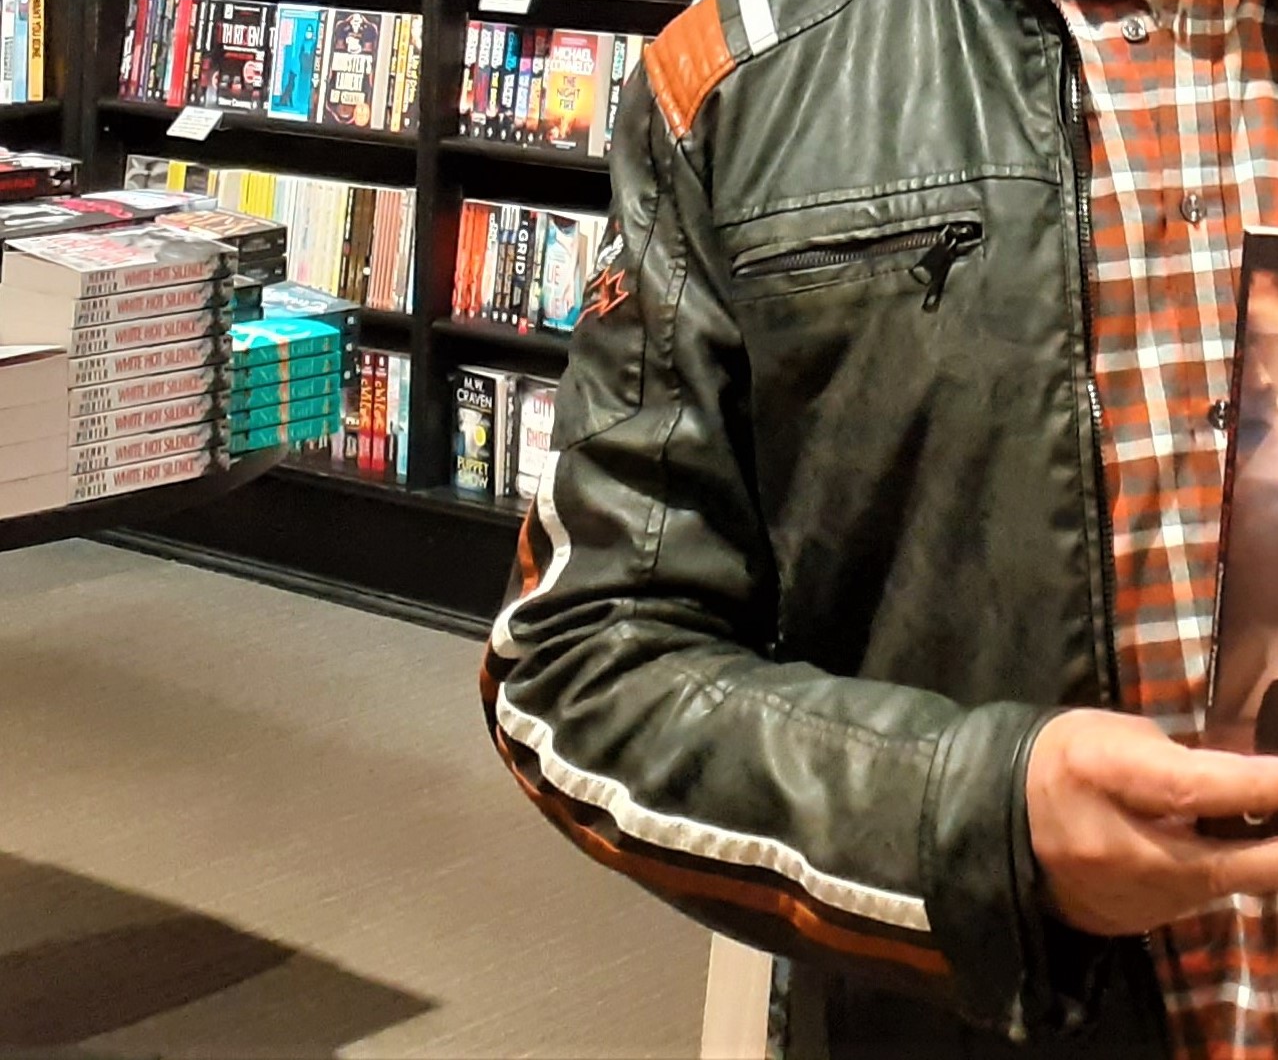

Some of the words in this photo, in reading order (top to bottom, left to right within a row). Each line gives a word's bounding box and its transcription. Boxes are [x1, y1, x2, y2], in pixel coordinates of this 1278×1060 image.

[31, 21, 42, 37] YOU
[562, 75, 577, 87] THE
[556, 88, 581, 100] NIGHT
[557, 99, 575, 111] FIRE
[456, 388, 493, 408] CRAVEN
